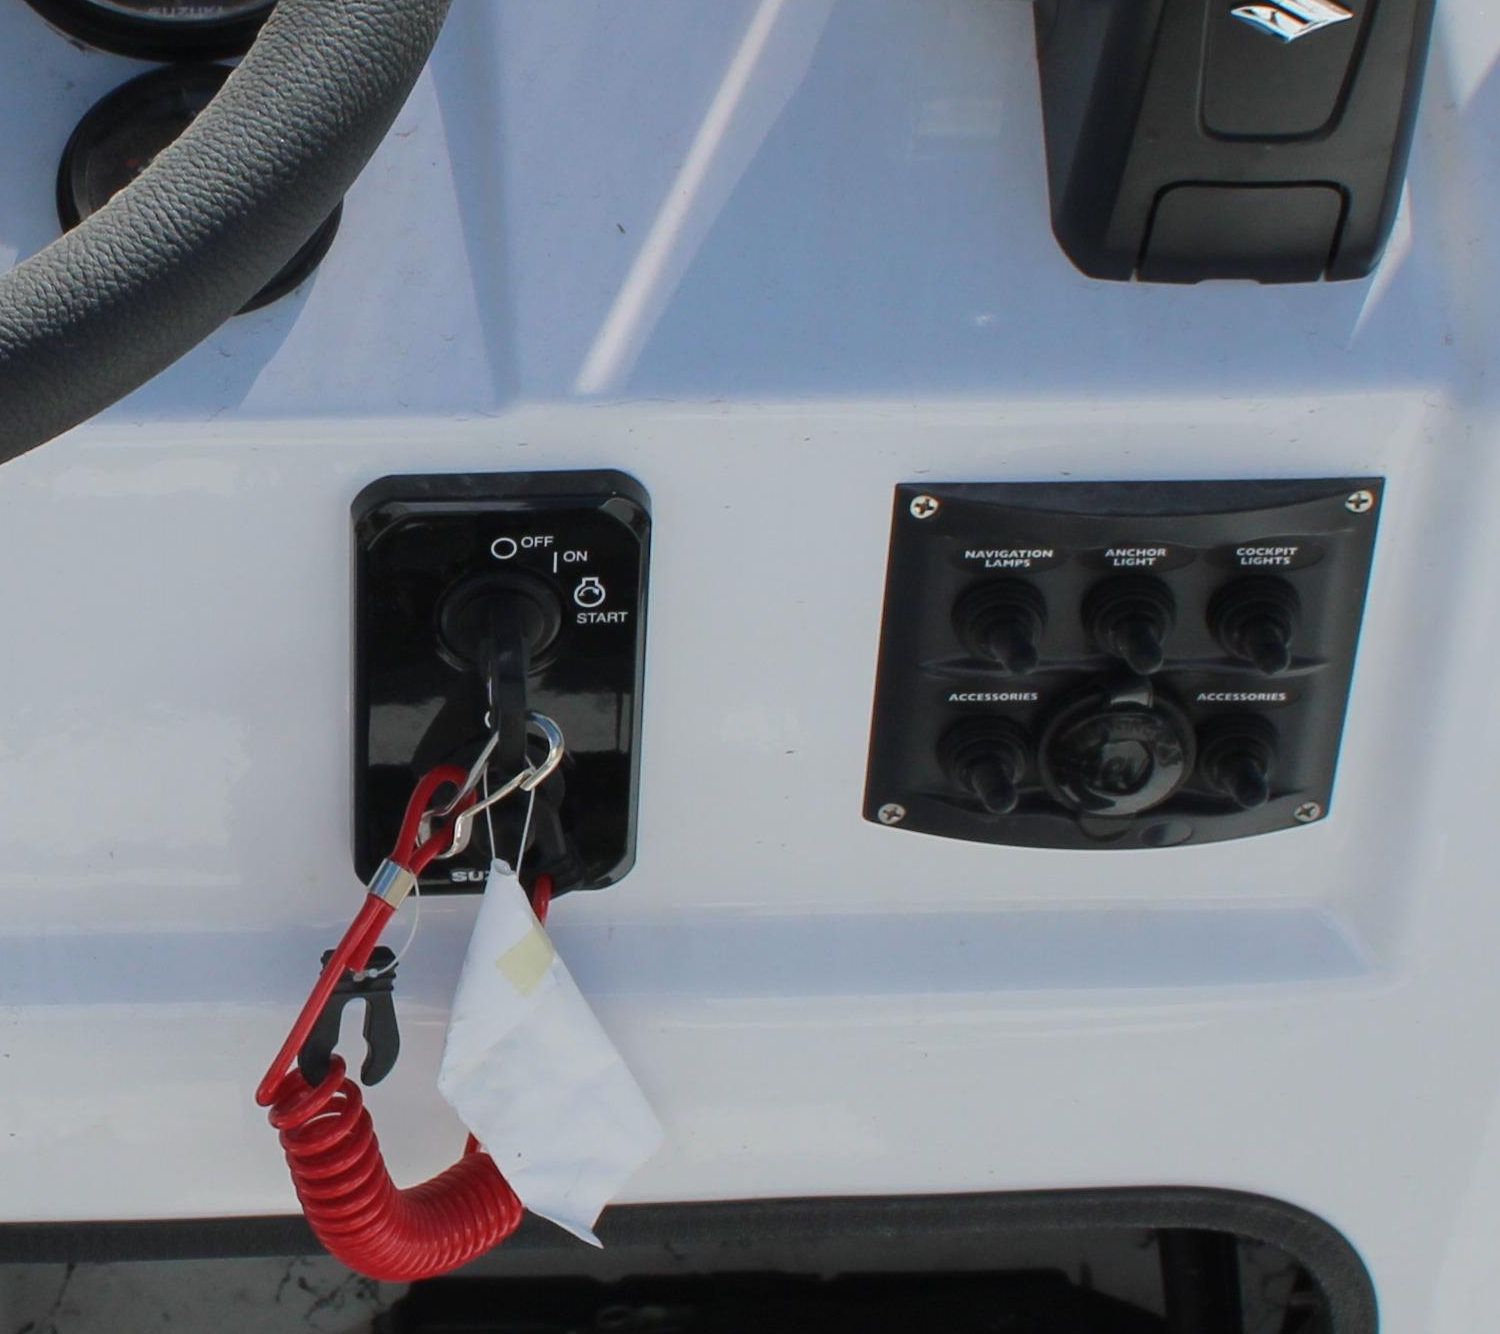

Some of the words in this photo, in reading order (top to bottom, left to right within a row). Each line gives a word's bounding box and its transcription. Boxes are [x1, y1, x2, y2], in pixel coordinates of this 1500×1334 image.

[521, 535, 555, 548] OFF
[563, 550, 589, 563] ON
[964, 548, 1054, 560] NAVIGATION
[1105, 547, 1167, 558] ANCHOR
[1236, 545, 1299, 557] COCKPIT
[984, 558, 1031, 568] LAMPS
[1112, 556, 1156, 567] LIGHT
[1240, 555, 1292, 566] LIGHTS
[576, 611, 629, 625] START
[948, 691, 1039, 702] ACCESSORIES
[1197, 691, 1287, 702] ACCESSORIES
